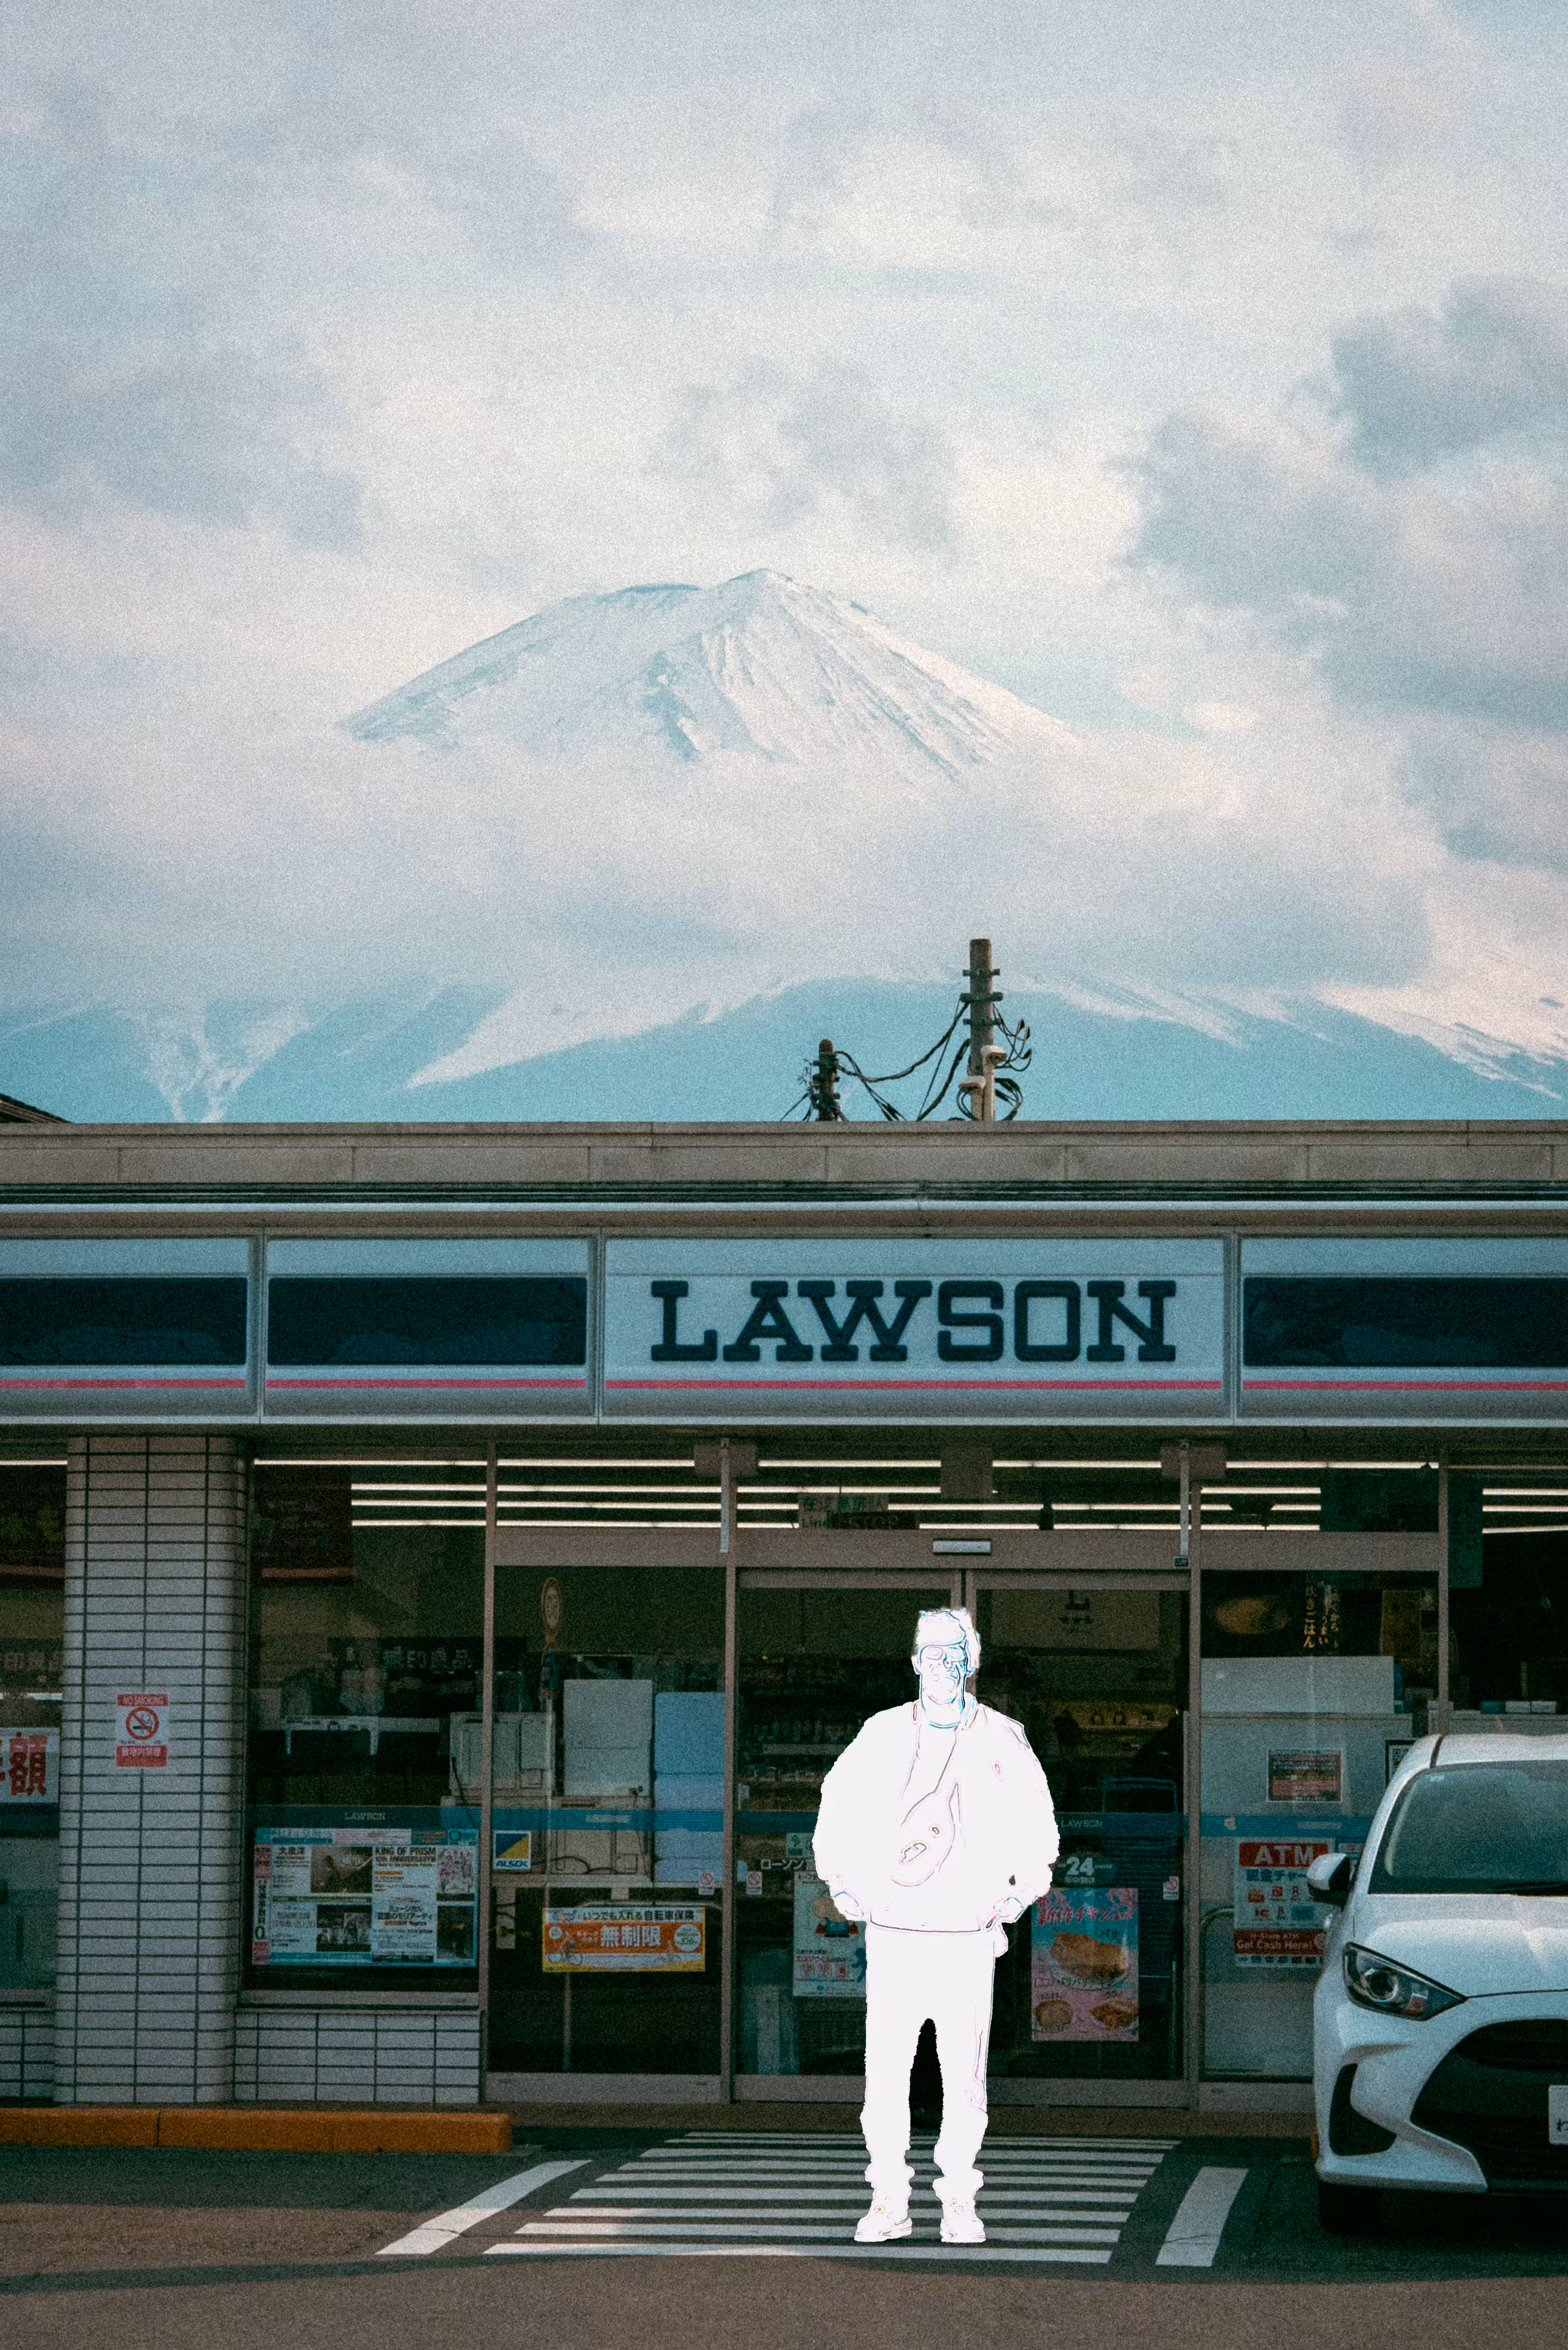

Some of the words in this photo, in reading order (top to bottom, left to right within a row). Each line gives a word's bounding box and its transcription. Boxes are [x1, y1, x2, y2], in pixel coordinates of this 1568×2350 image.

[651, 1280, 1176, 1362] LAWSON
[123, 1695, 133, 1705] NO
[134, 1695, 164, 1705] SMOKING
[0, 1732, 47, 1796] 額
[761, 1859, 804, 1869] ローソン
[1254, 1845, 1314, 1865] ATM
[1066, 1857, 1095, 1876] 24
[601, 1926, 661, 1947] 無制限
[1236, 1940, 1253, 1949] Get
[1256, 1940, 1281, 1949] Cash
[1285, 1940, 1312, 1949] Here!
